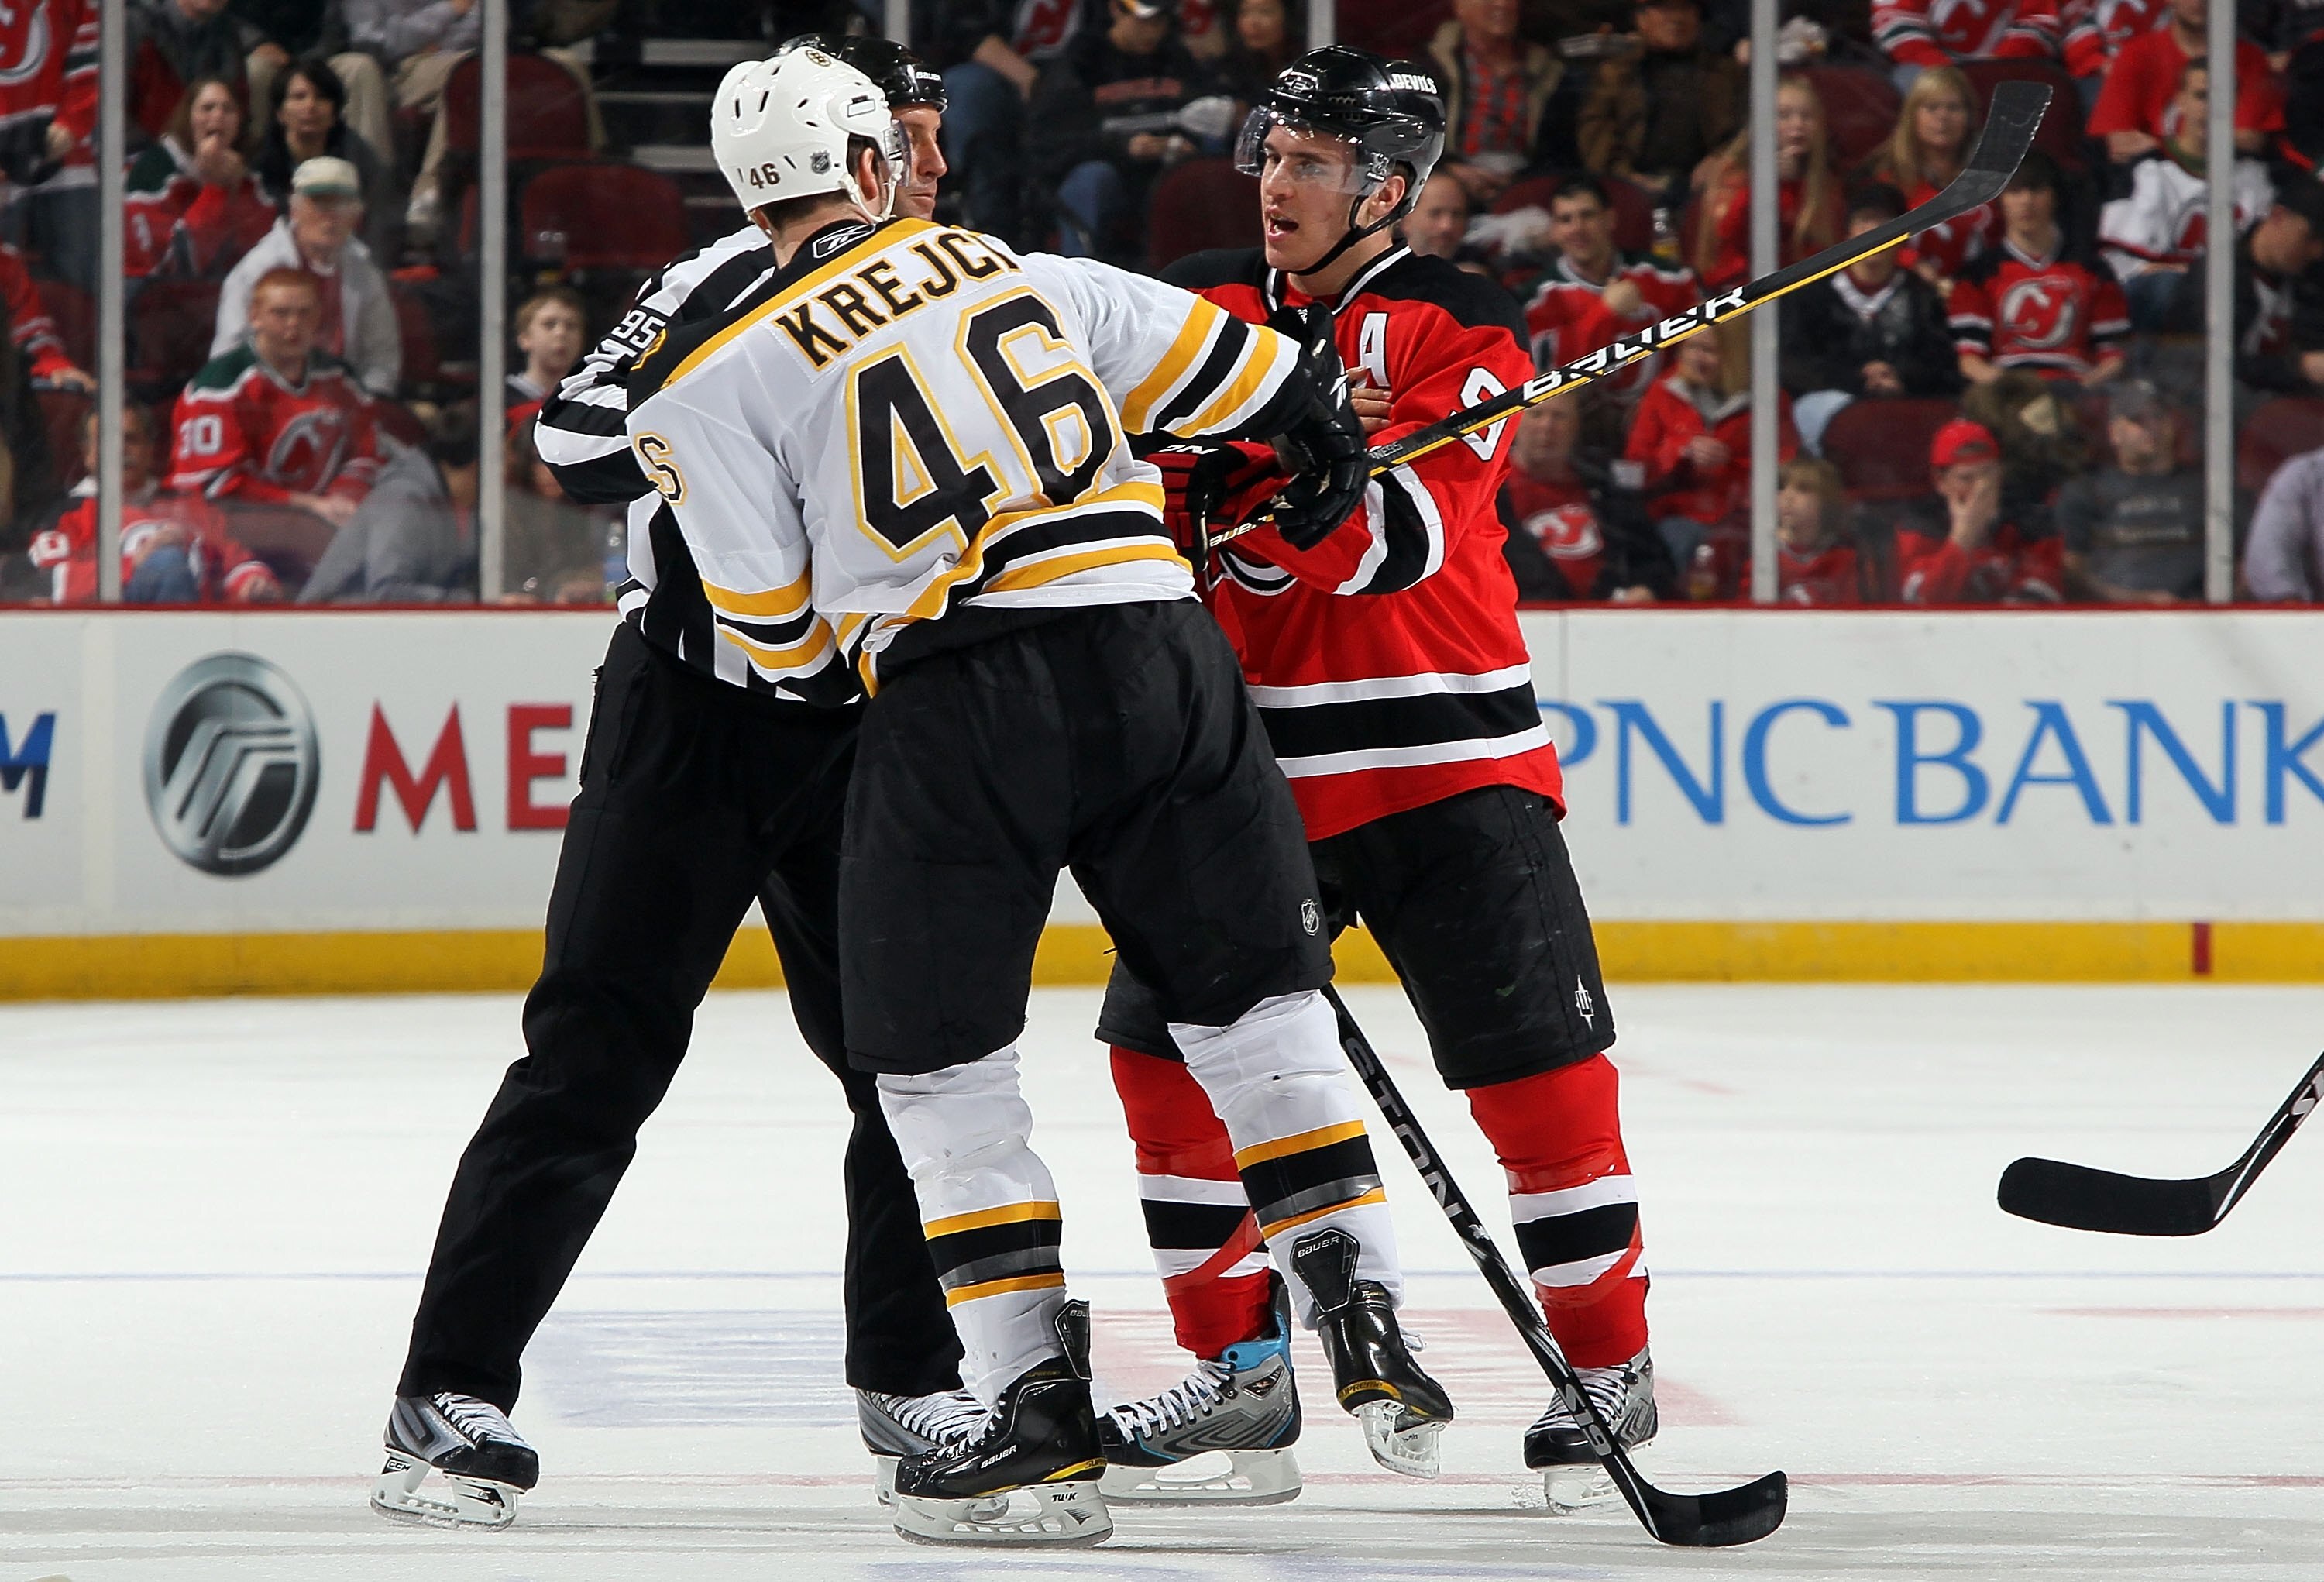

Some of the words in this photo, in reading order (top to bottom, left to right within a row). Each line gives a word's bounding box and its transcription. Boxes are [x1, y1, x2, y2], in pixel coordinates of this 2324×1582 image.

[916, 71, 942, 81] BAUE
[750, 163, 782, 189] 46
[611, 309, 666, 349] 95
[1523, 285, 1747, 401] BAUER
[1359, 312, 1391, 388] A
[844, 285, 1121, 564] 46
[1869, 699, 2324, 826] BANK
[1298, 1236, 1339, 1259] BAUER
[388, 1461, 411, 1471] CCM
[980, 1444, 1018, 1469] BAUER
